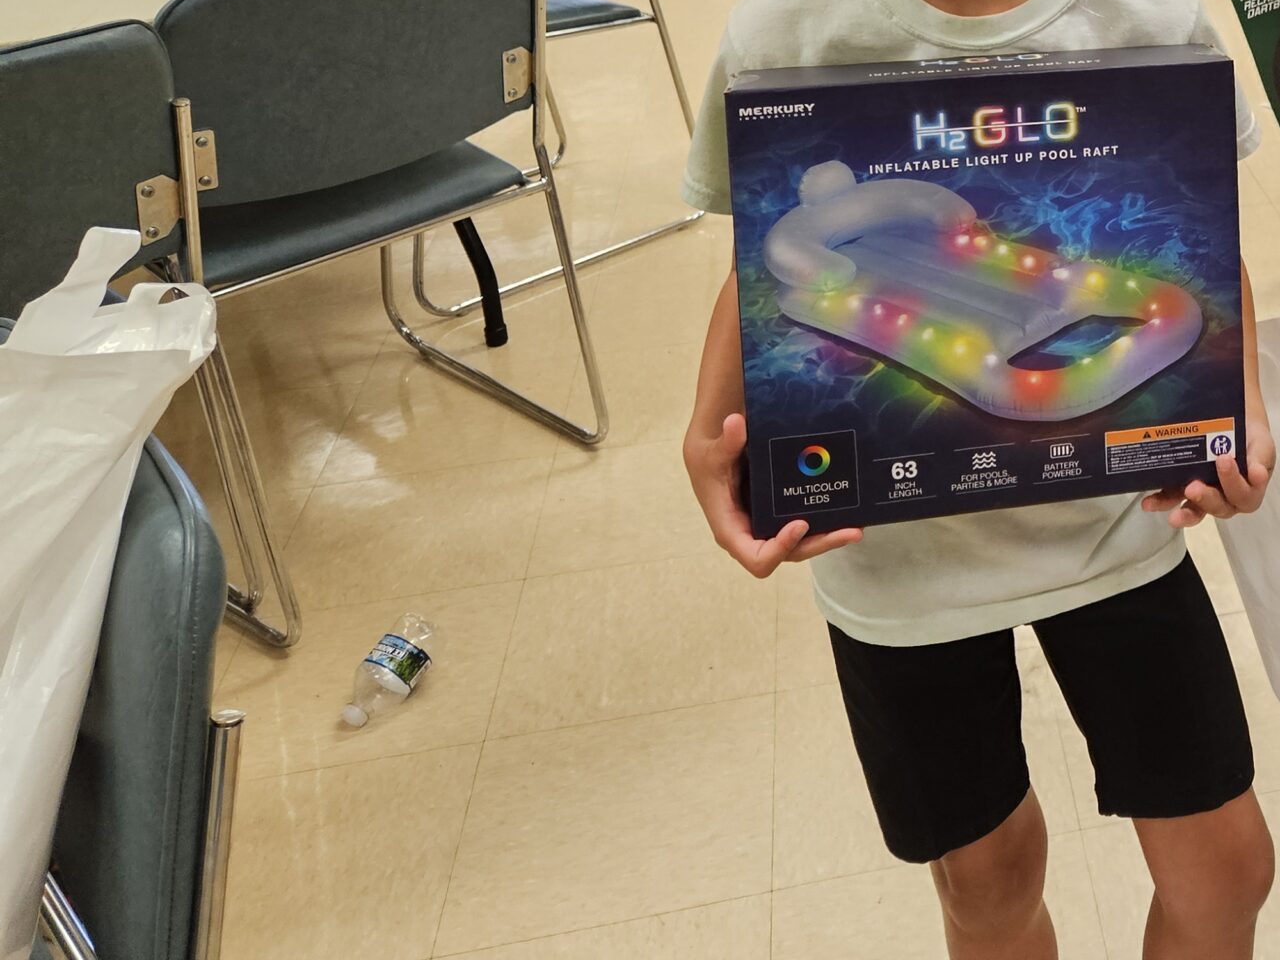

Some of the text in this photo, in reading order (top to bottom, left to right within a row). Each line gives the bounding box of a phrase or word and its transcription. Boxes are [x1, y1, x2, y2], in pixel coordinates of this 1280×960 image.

[738, 103, 815, 117] MERKURY
[869, 145, 1119, 175] INFLATABLE LIGHT UP POOL RAFT
[1155, 425, 1199, 438] WARNING
[890, 460, 918, 480] 63
[1043, 460, 1080, 472] BATTERY
[960, 473, 978, 483] FOR
[1042, 468, 1082, 480] POWERED
[783, 480, 849, 497] MULTICOLOR
[894, 481, 916, 490] INCH
[951, 476, 1018, 492] PARTIES & MORE
[888, 488, 923, 499] LENGTH
[804, 494, 830, 506] LEDS
